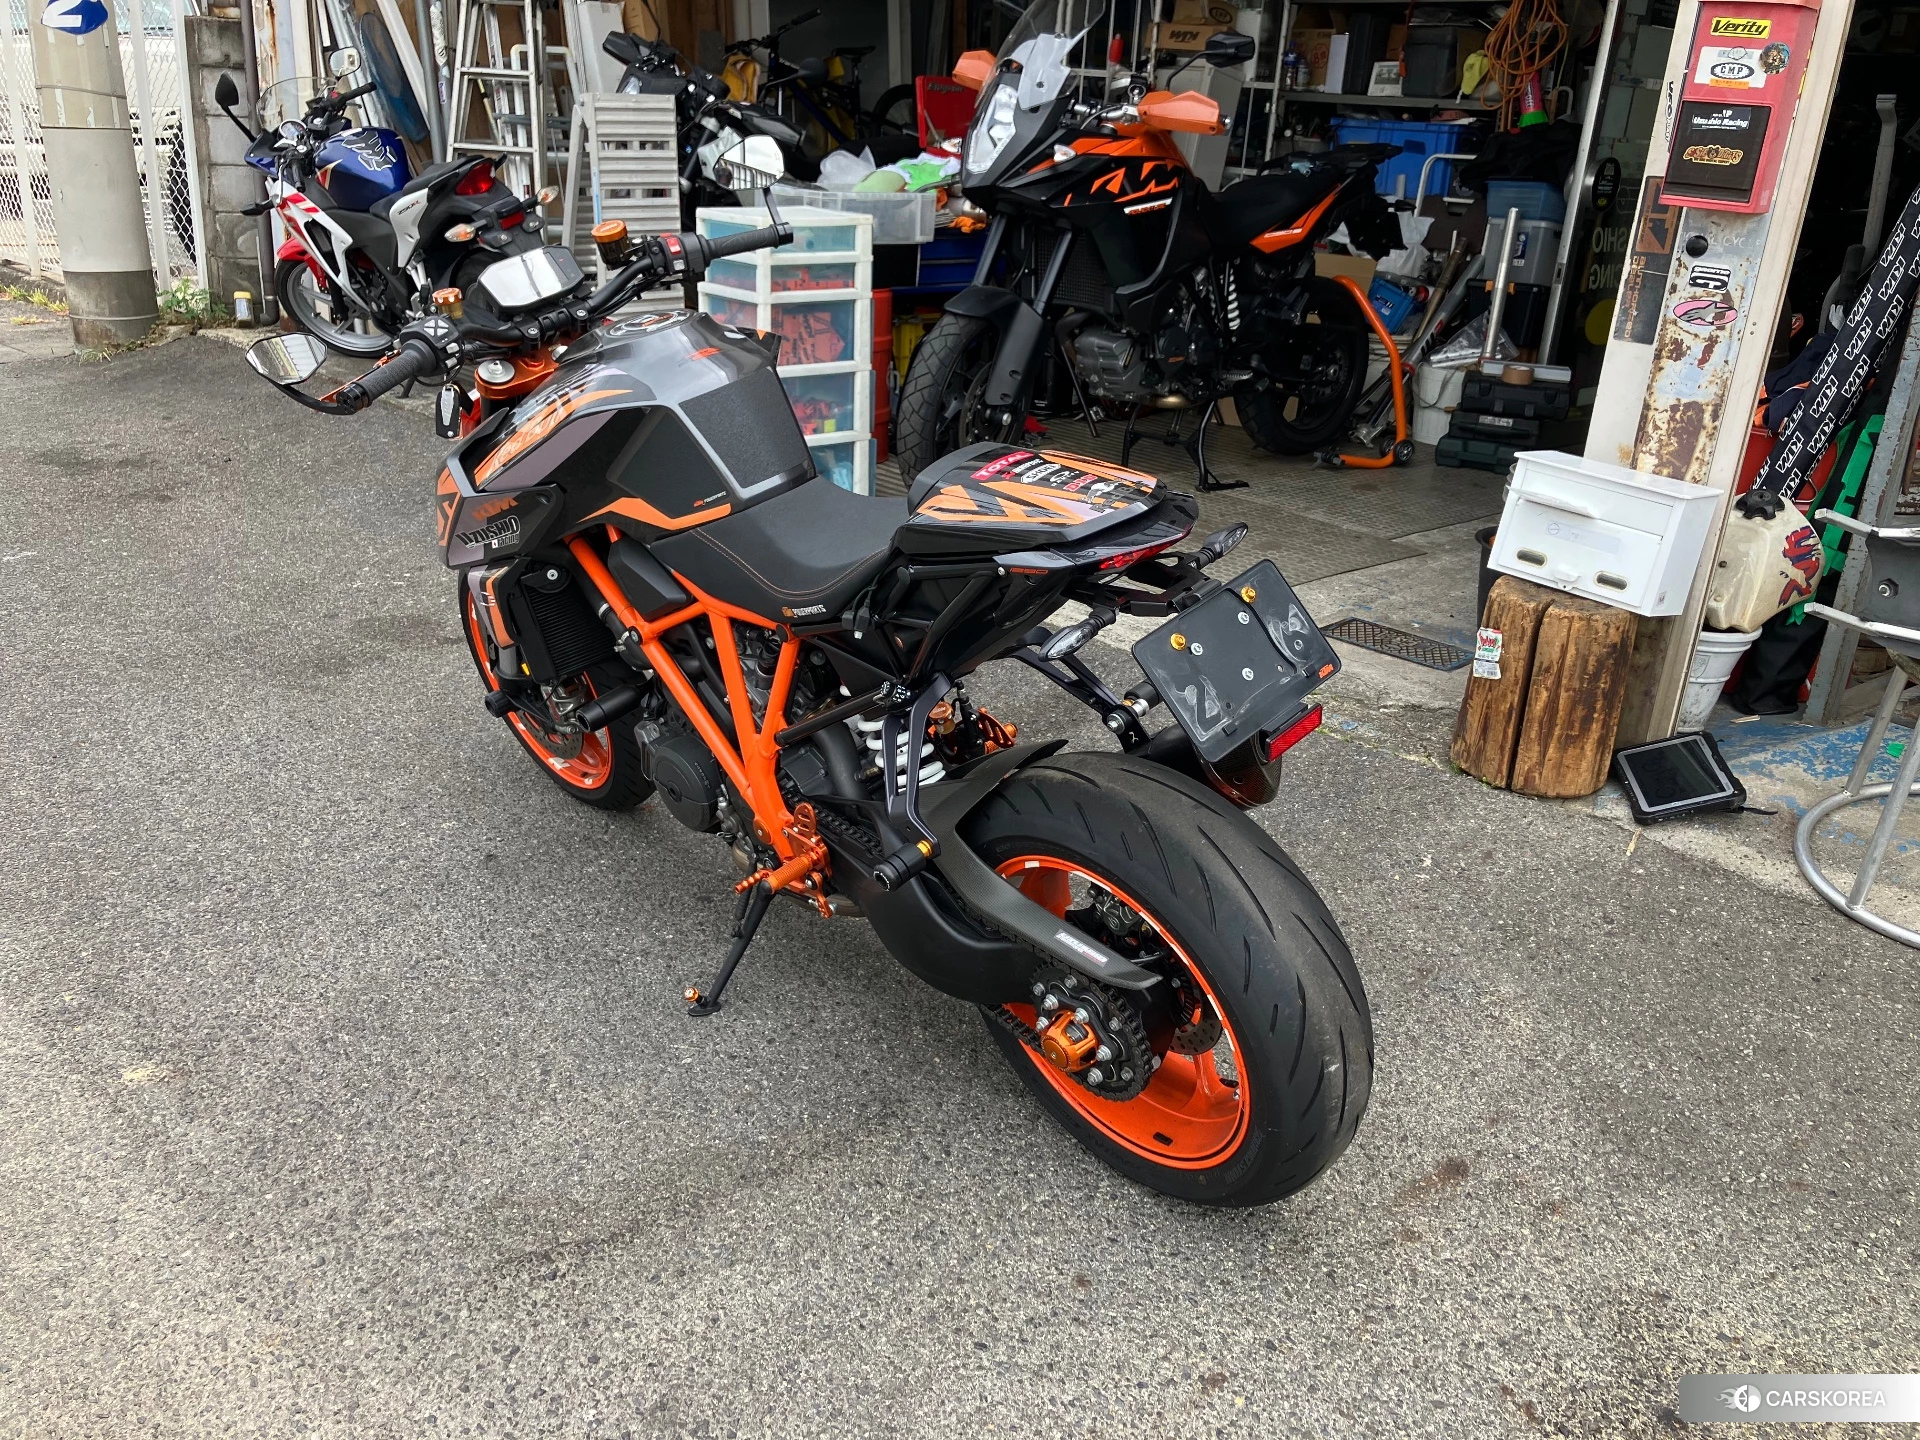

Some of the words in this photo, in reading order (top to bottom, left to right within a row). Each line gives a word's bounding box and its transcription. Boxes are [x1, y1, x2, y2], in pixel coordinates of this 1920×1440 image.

[1712, 19, 1768, 36] Verity
[1720, 65, 1744, 75] CMP
[1722, 117, 1749, 128] Racing
[977, 452, 1030, 477] TOTAL
[472, 496, 518, 521] KTM
[455, 515, 520, 549] UZUSHIO
[498, 533, 520, 548] racing
